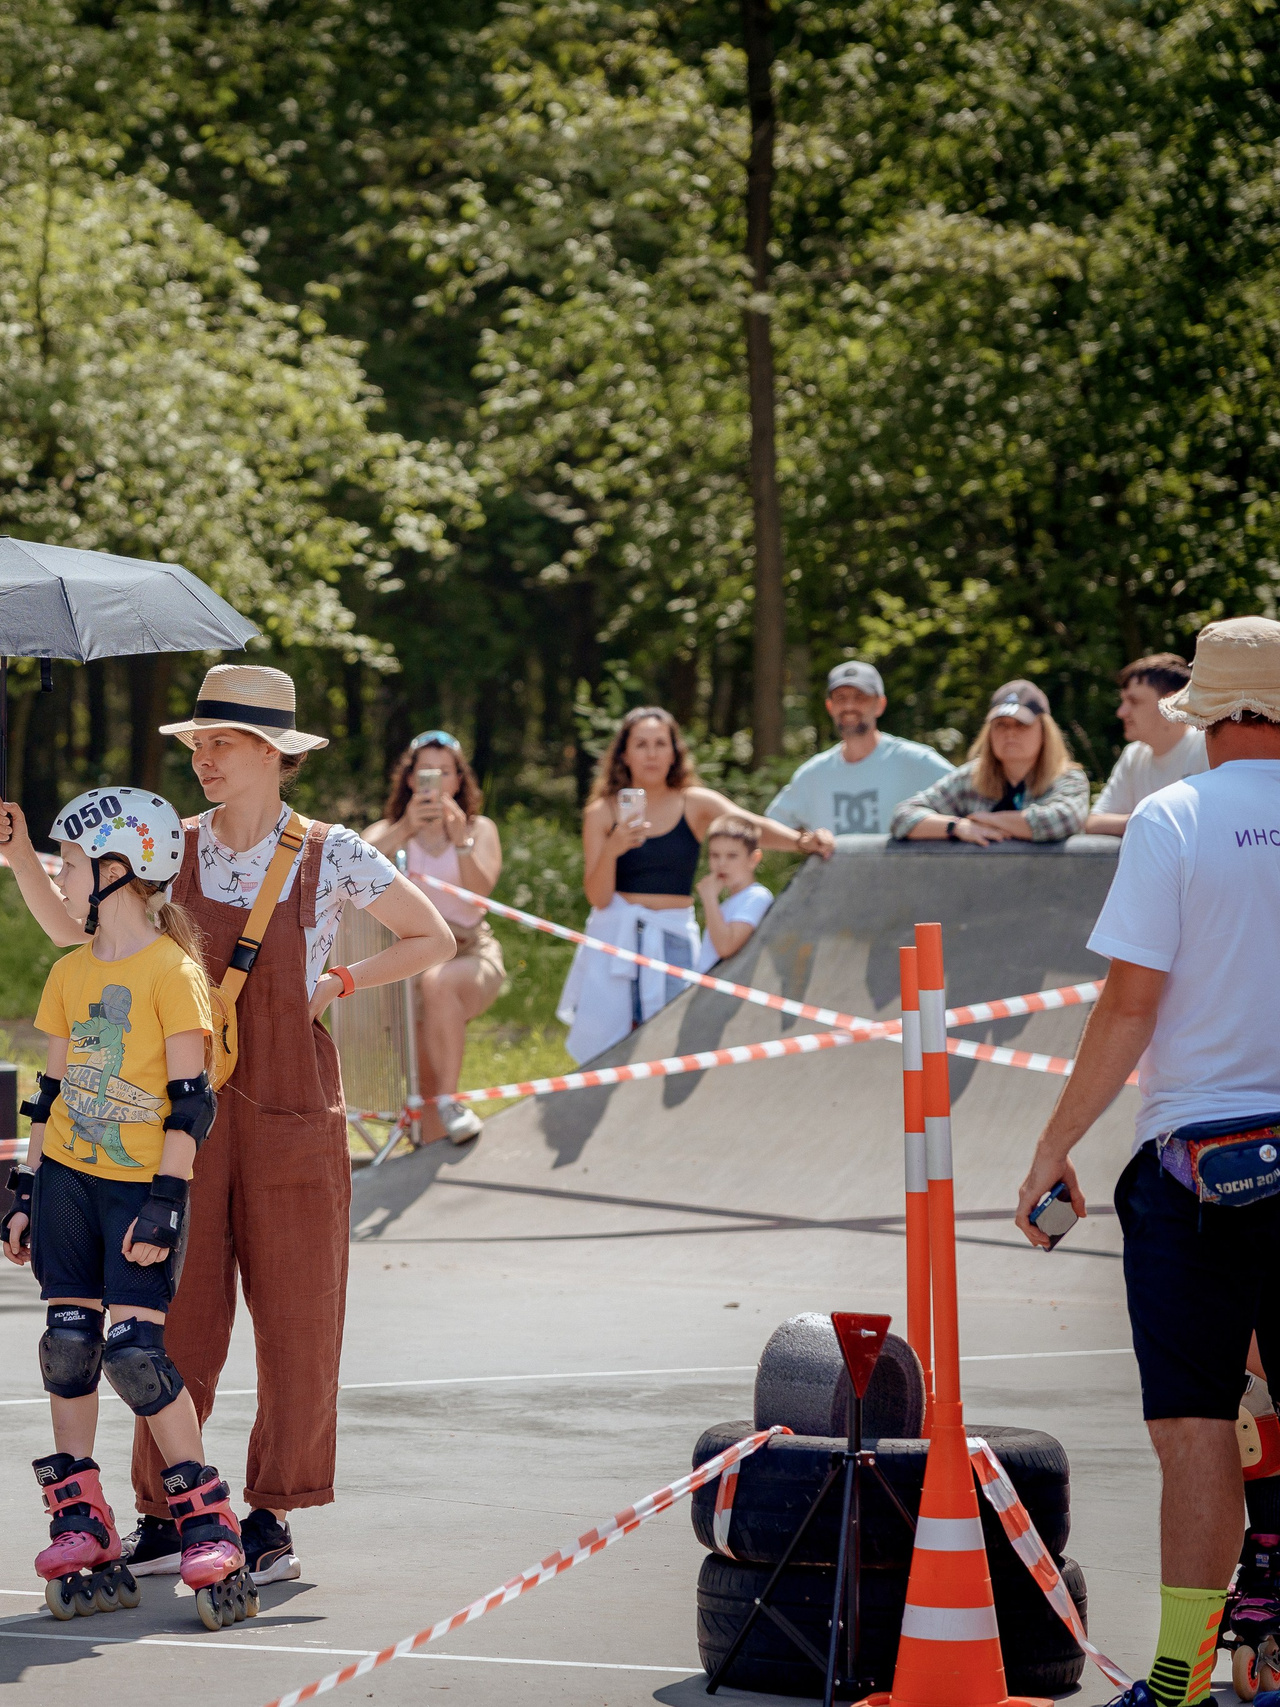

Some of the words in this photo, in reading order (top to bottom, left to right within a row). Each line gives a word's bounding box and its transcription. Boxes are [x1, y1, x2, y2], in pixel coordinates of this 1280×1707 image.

[63, 795, 122, 841] 050
[77, 1094, 130, 1122] WAVES
[1214, 1177, 1254, 1195] SOCHI
[54, 1310, 80, 1319] FLYING
[63, 1314, 86, 1322] EAGLE
[112, 1324, 132, 1338] EAGLE
